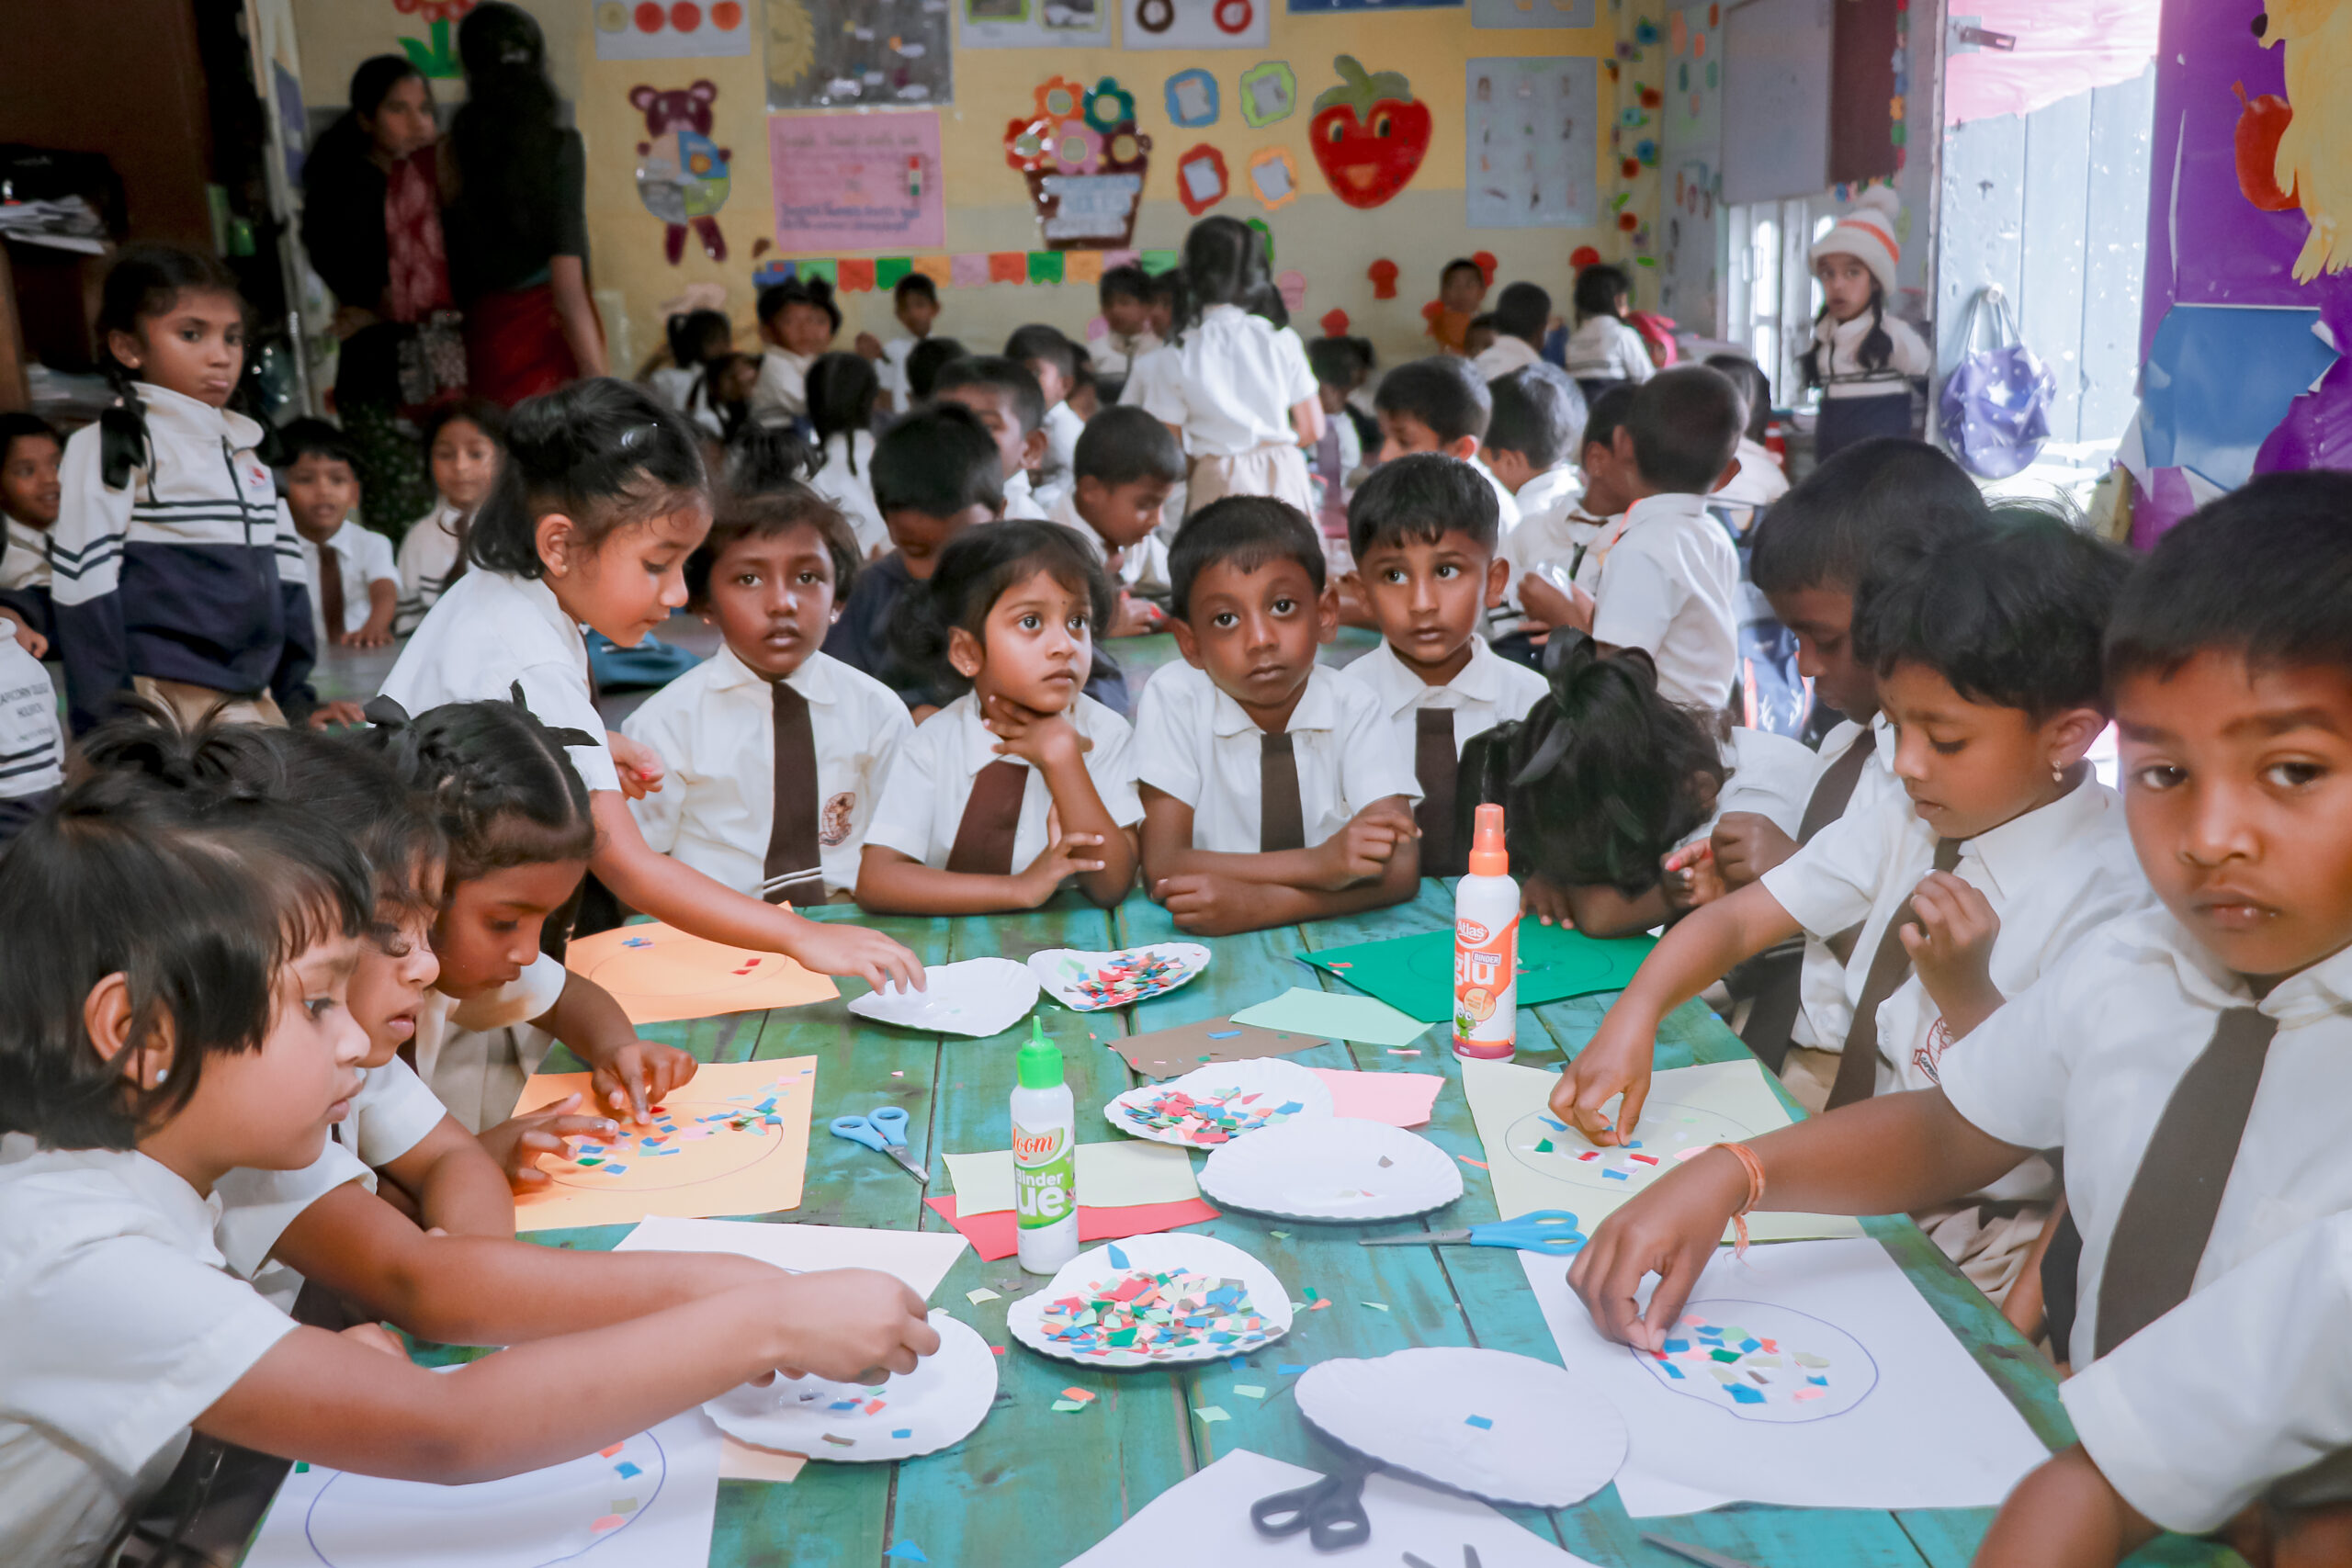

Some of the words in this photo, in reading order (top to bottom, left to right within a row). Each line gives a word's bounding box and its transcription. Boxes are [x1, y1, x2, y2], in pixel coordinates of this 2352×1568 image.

[1457, 920, 1485, 938] Atlas
[1474, 953, 1499, 964] BINDER
[1016, 1168, 1064, 1187] Binder
